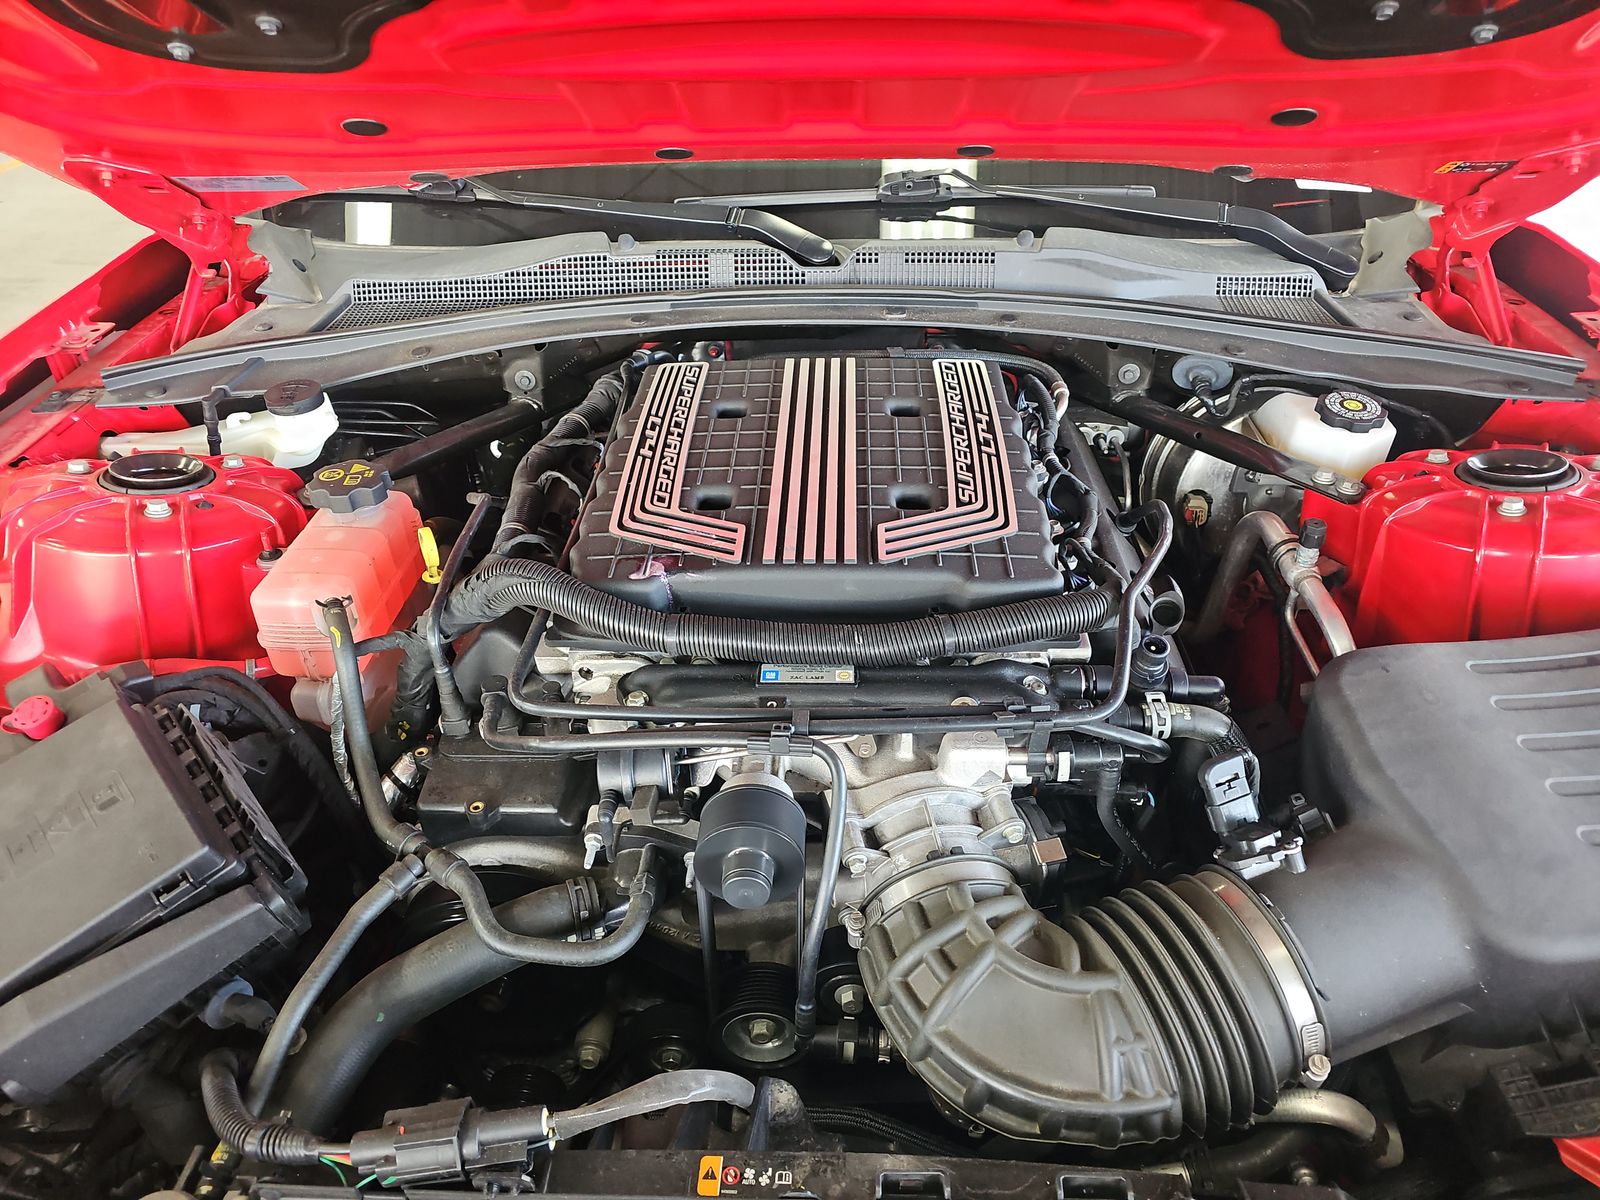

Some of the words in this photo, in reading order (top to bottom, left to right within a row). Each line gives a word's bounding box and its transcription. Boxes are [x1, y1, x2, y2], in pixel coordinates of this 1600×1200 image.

[640, 415, 662, 459] LT4
[652, 365, 700, 509] SUPERCHARGED
[941, 361, 976, 504] SUPERCHARGED
[975, 412, 997, 457] LT4
[765, 671, 776, 679] GM
